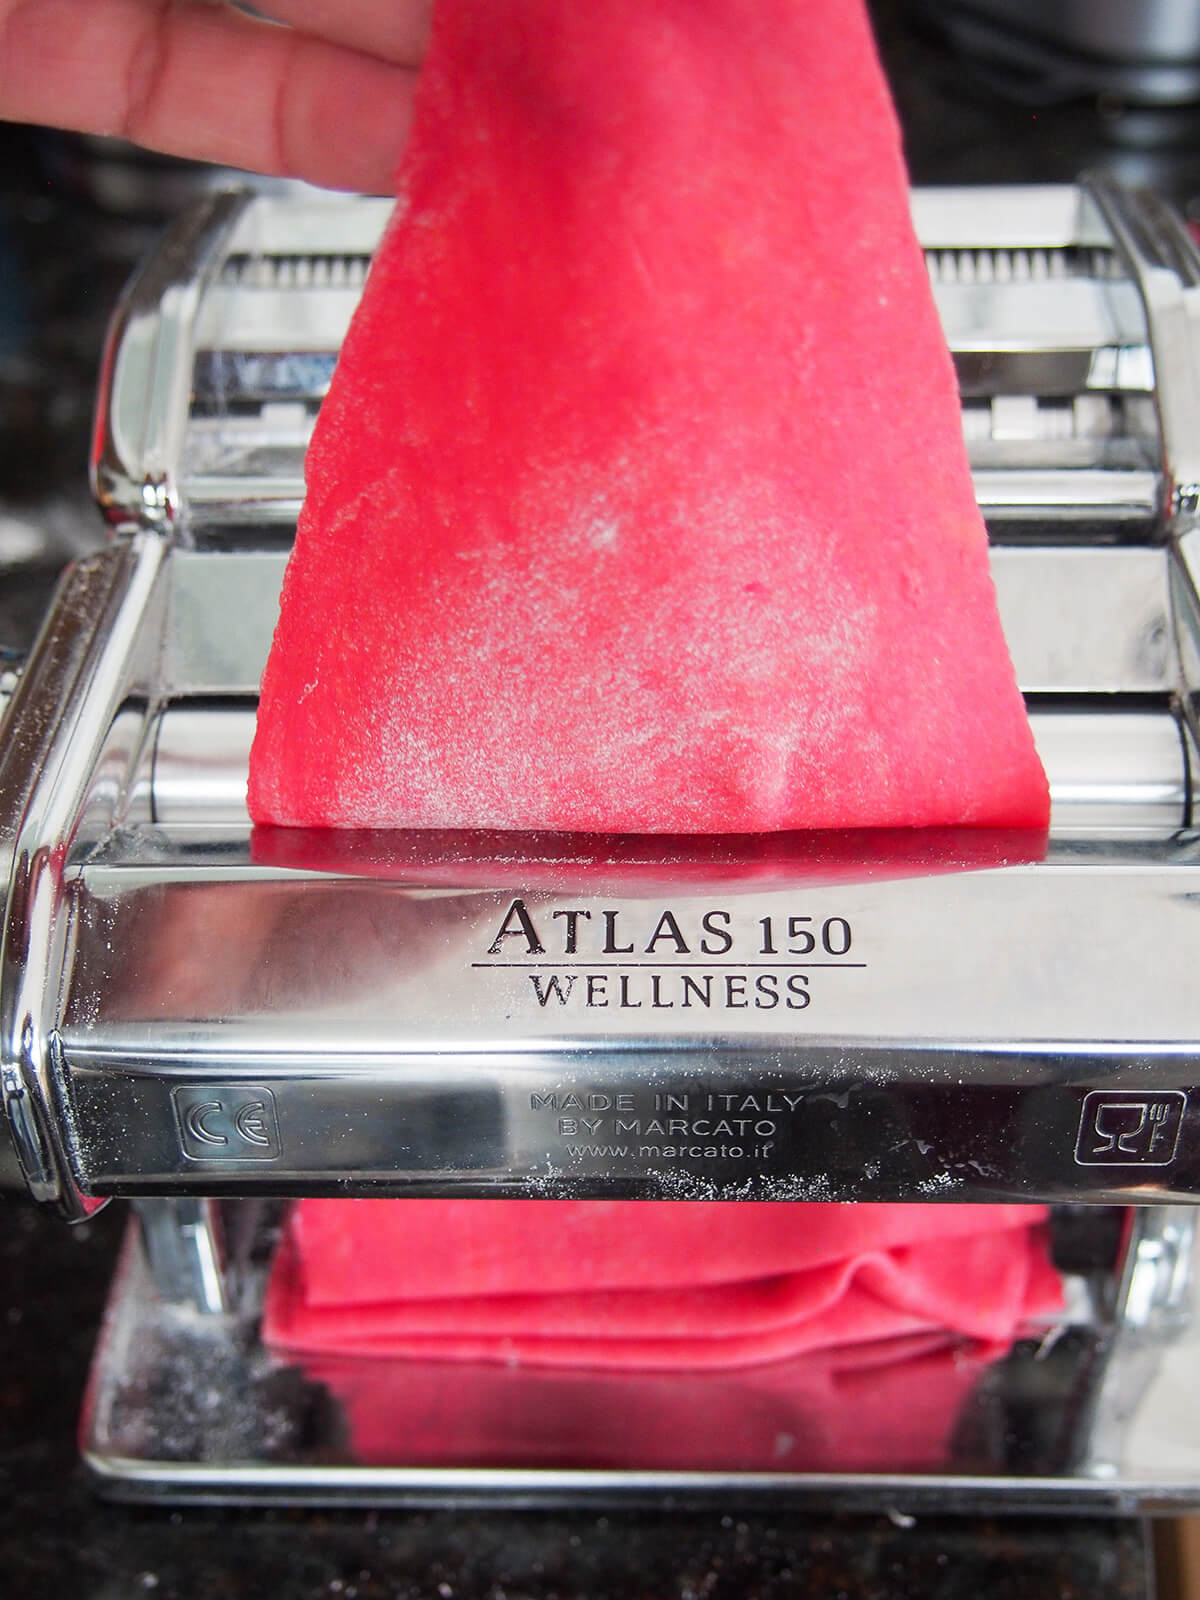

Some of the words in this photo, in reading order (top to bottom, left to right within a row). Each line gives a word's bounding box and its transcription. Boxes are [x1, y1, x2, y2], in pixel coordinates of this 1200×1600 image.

[488, 898, 733, 955] ATLAS
[759, 916, 852, 956] 150
[529, 974, 811, 1010] WELLNESS
[530, 1094, 634, 1112] MADE
[655, 1093, 689, 1112] IN
[707, 1093, 804, 1112] ITALY
[558, 1118, 601, 1137] BY
[615, 1118, 777, 1137] MARCATO
[566, 1142, 771, 1159] www.marcato.it
